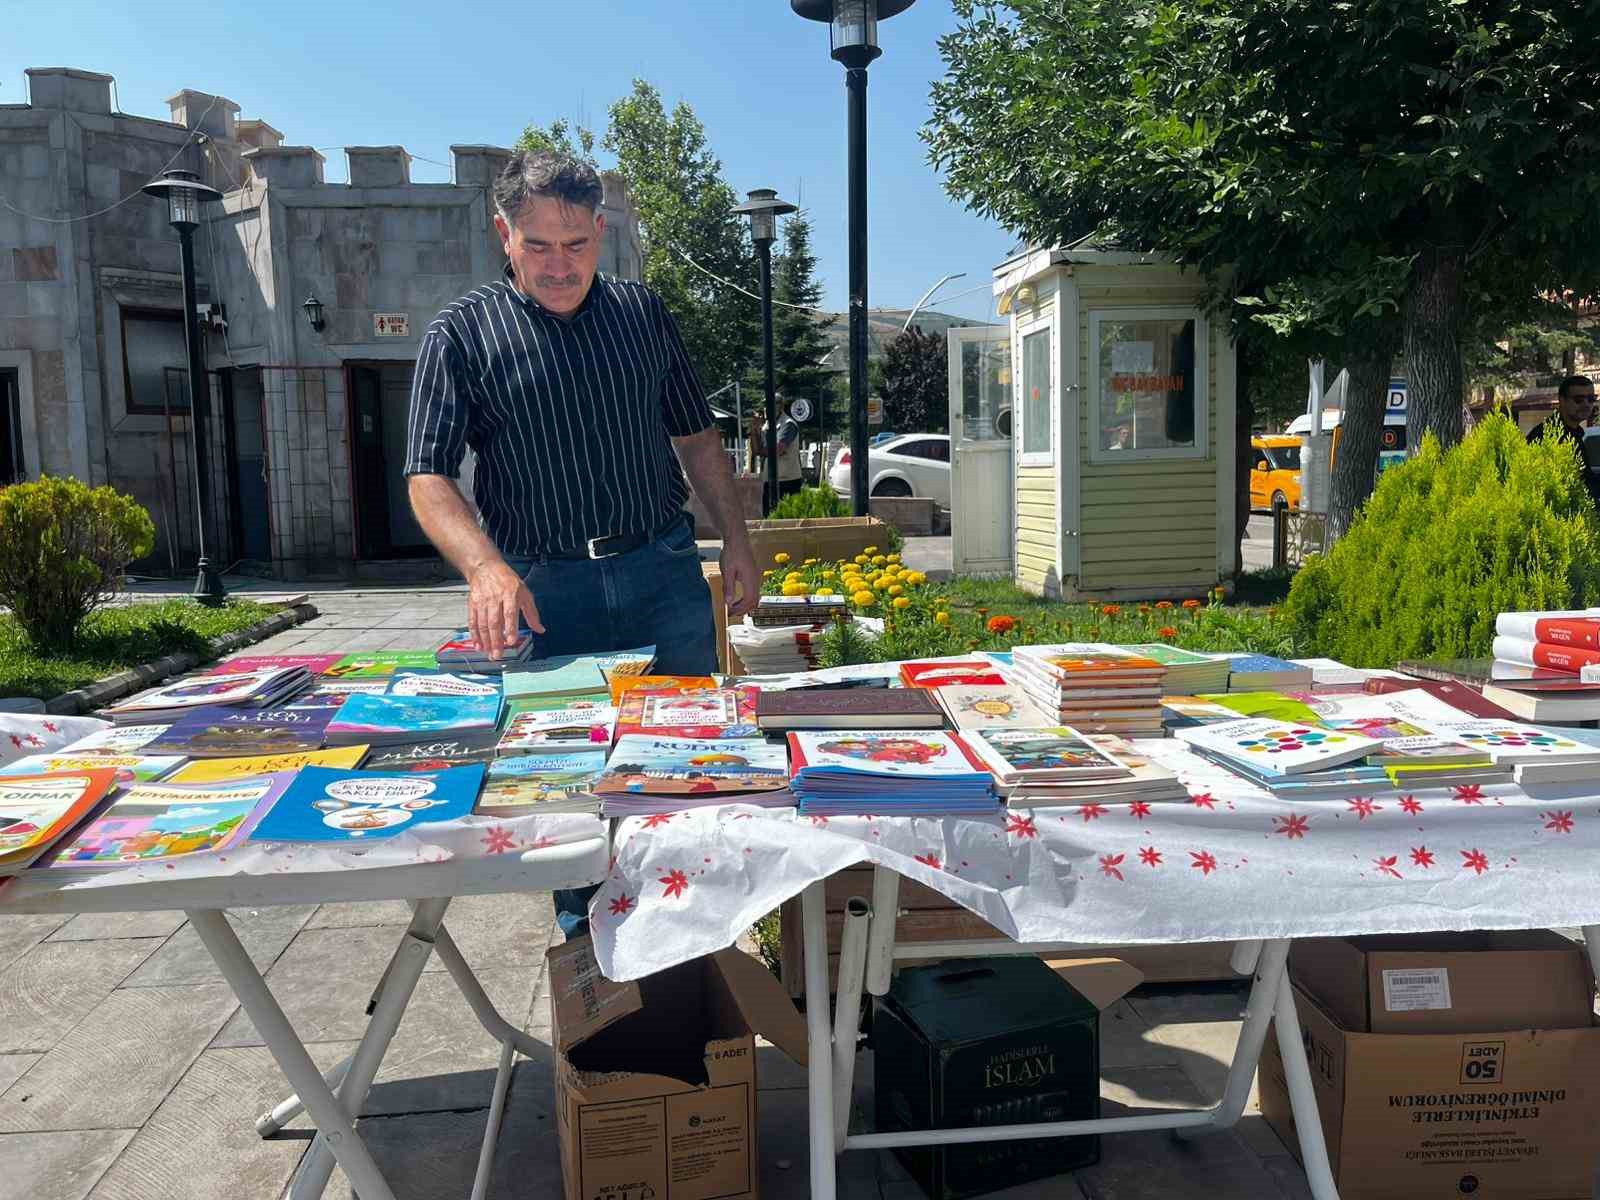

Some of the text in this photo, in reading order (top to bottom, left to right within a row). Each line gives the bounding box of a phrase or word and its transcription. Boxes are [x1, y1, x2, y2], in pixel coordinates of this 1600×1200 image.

[391, 324, 403, 333] WC
[1389, 391, 1405, 408] D
[723, 1048, 748, 1059] ADET
[1468, 1047, 1500, 1057] ADET
[984, 1053, 1057, 1089] İSLAM
[1465, 1060, 1498, 1079] 50
[1411, 1106, 1540, 1124] ETKİNLİKLERLE
